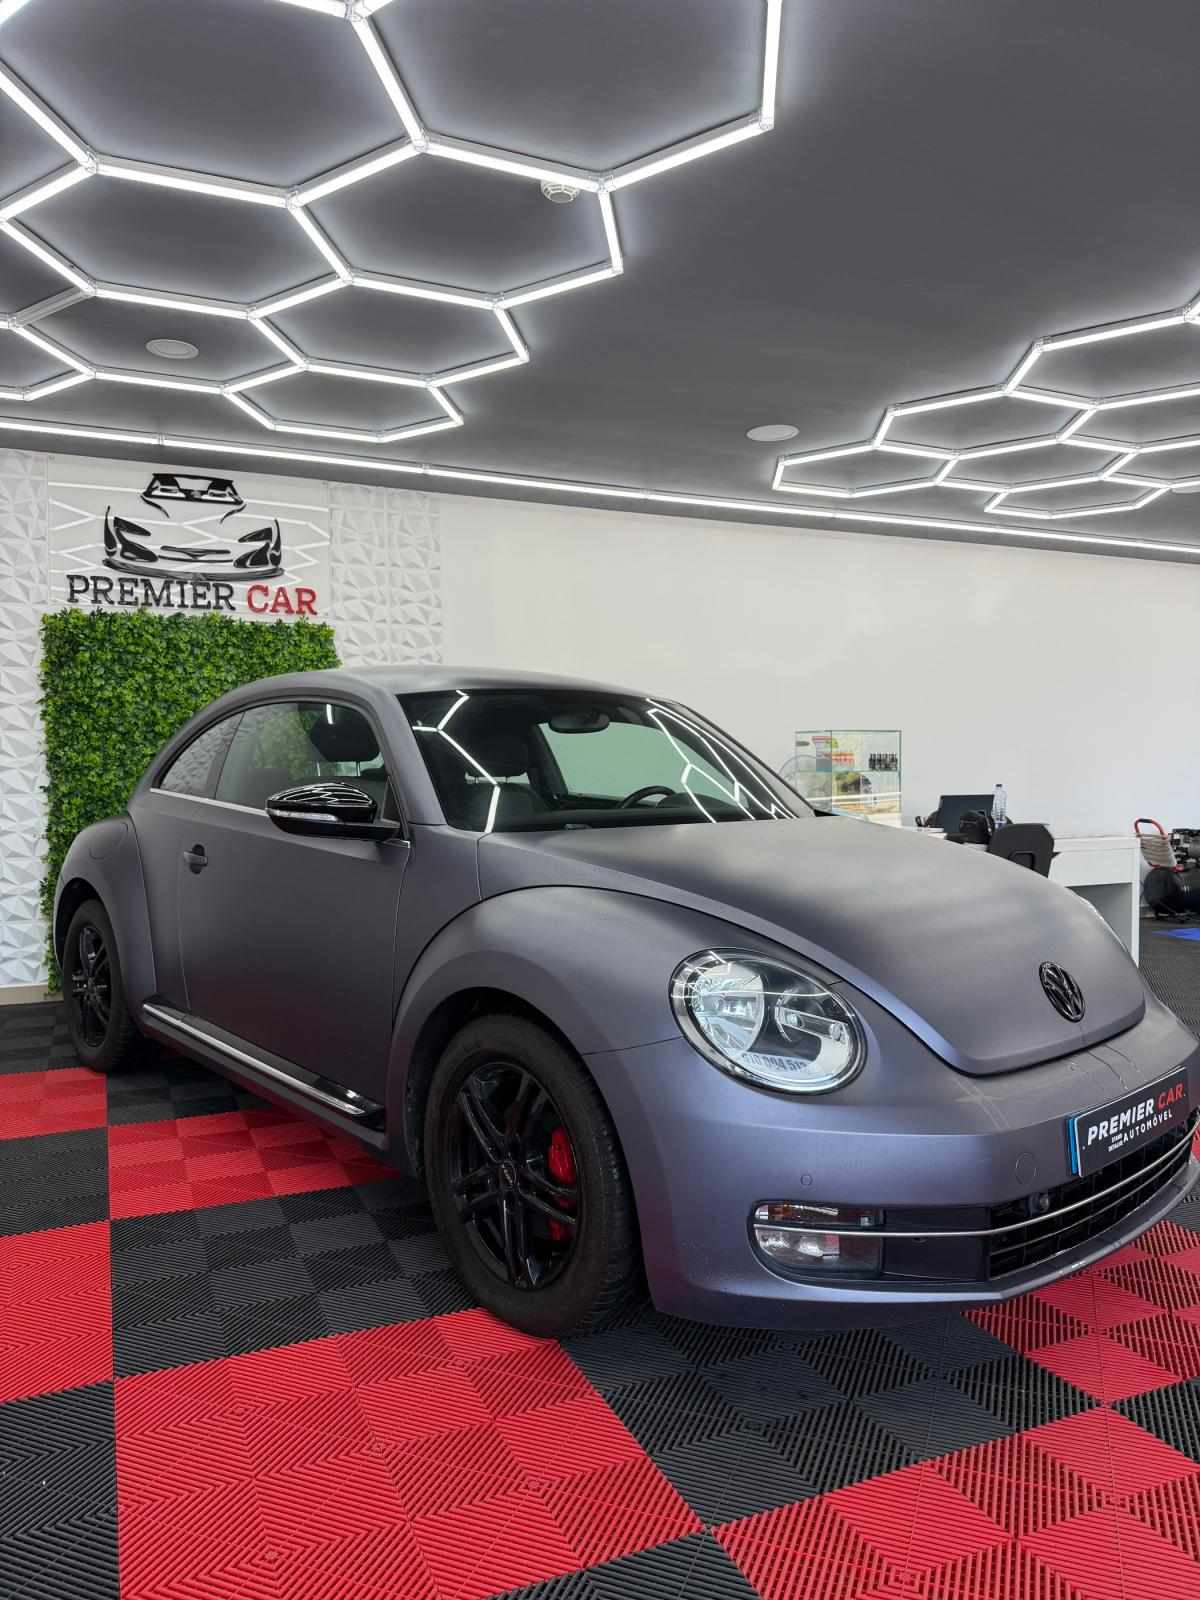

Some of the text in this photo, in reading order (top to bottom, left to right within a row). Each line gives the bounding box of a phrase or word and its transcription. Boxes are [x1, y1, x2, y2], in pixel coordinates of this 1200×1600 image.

[66, 574, 318, 616] PREMIER CAR
[1087, 1098, 1154, 1146] PREMIER
[1123, 1109, 1173, 1143] AUTOMÓVEL
